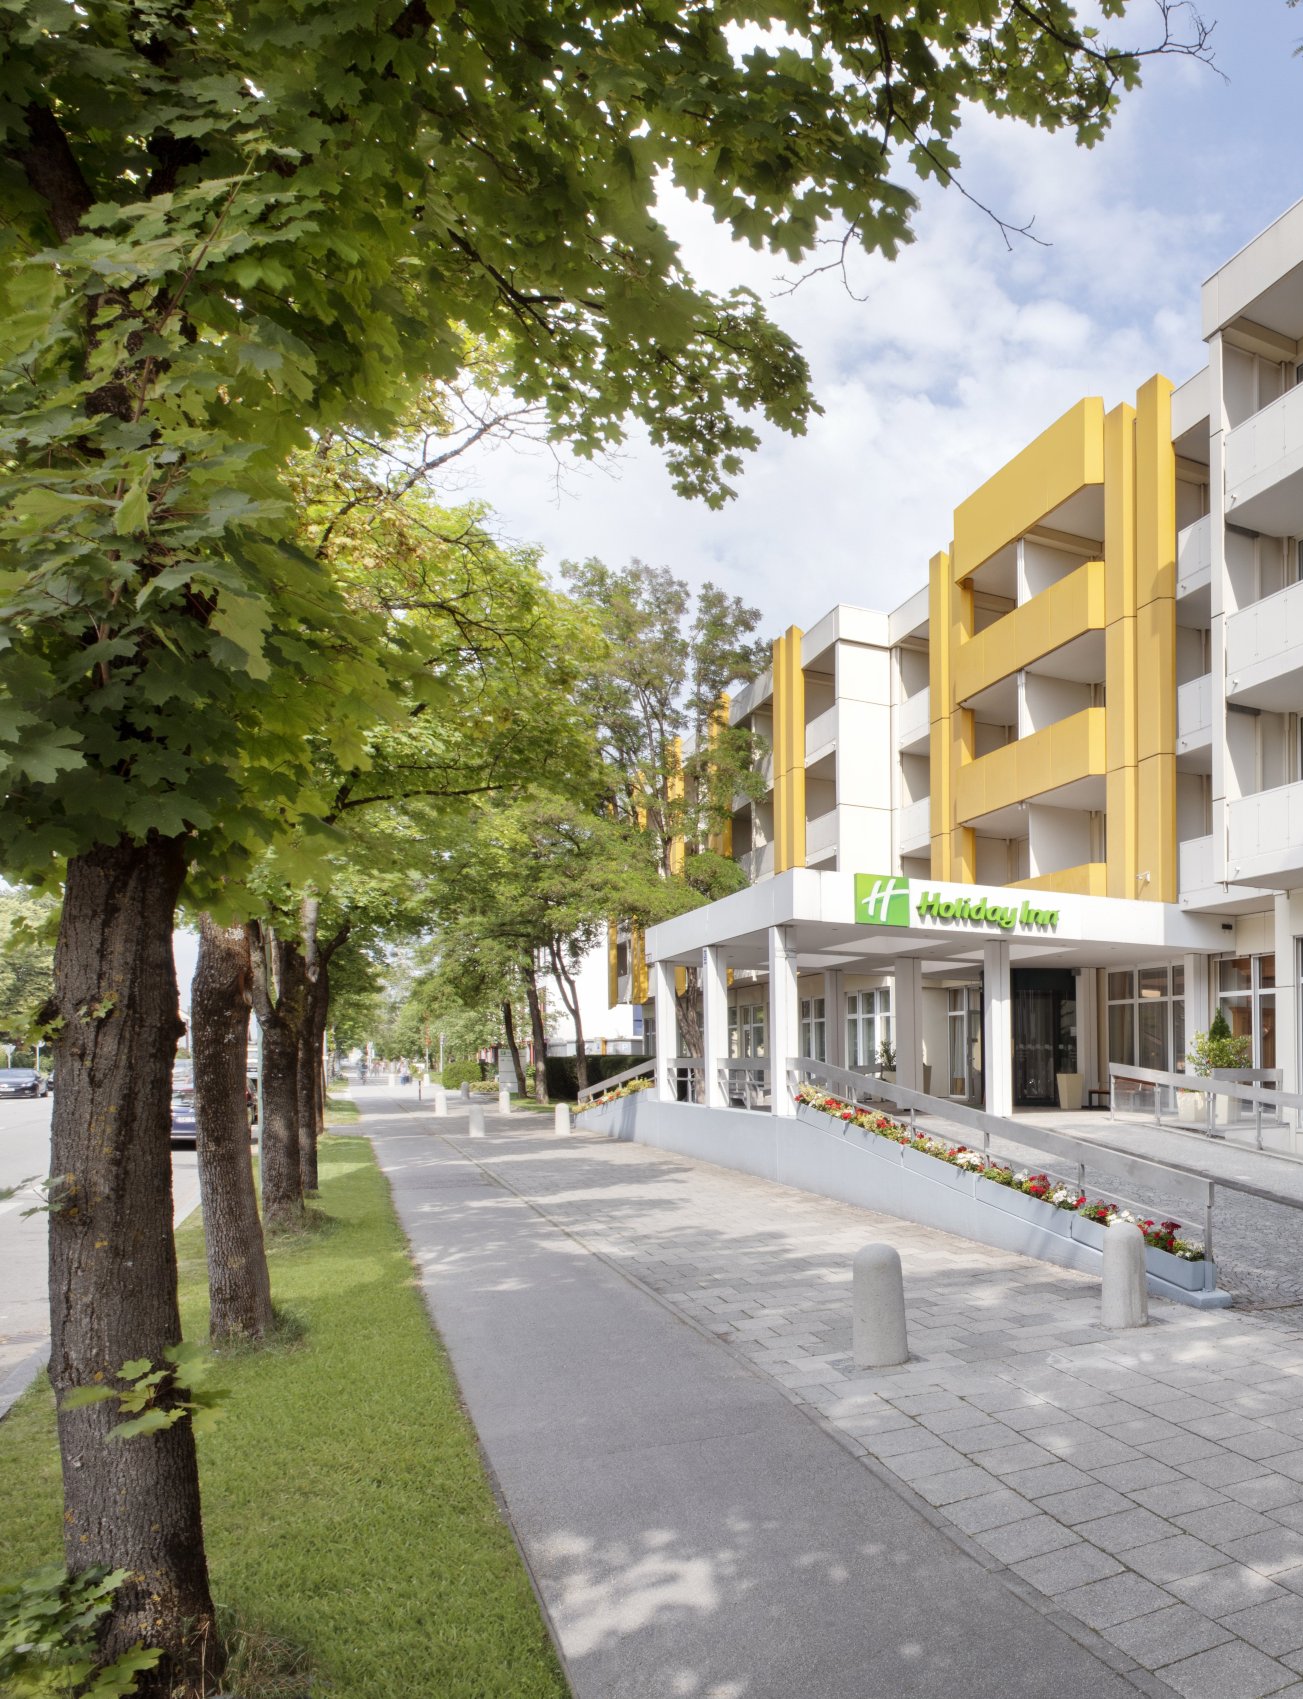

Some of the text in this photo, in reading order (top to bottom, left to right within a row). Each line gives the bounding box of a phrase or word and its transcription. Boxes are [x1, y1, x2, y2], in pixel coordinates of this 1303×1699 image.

[861, 878, 1059, 928] H Holiday Inn
